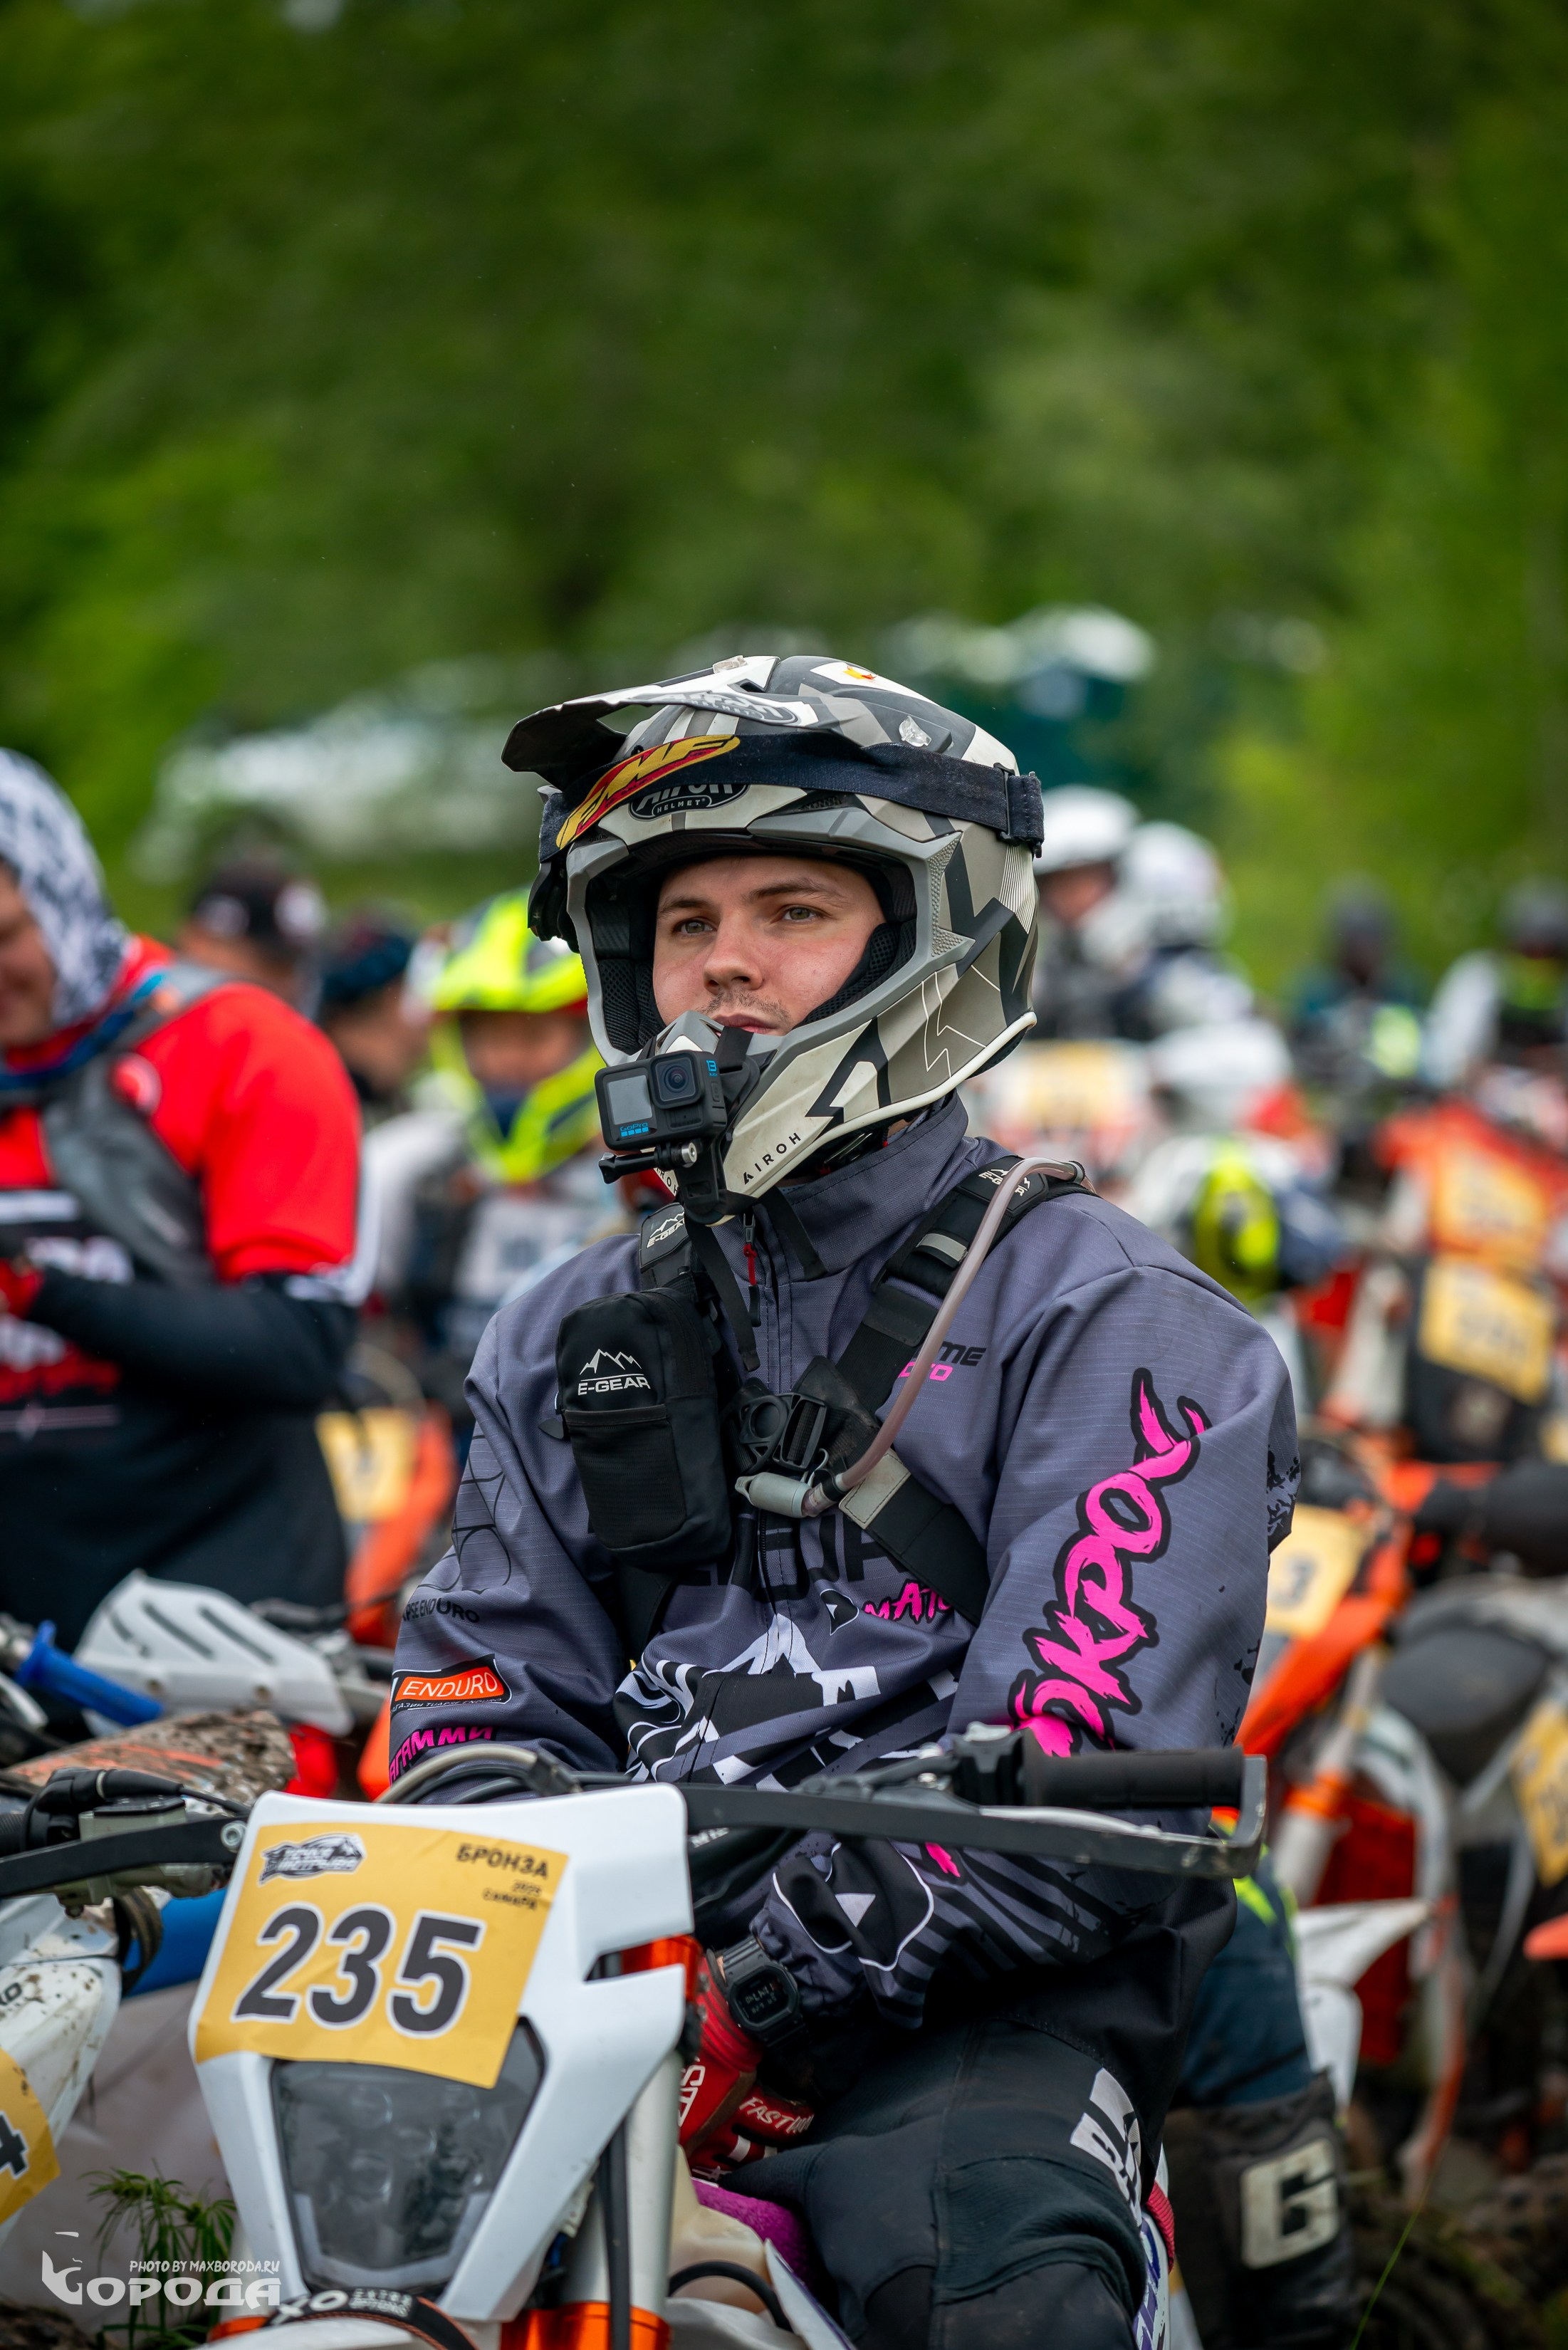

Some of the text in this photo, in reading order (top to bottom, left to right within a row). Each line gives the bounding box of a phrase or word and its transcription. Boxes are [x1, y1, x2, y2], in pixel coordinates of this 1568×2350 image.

[620, 1122, 648, 1132] GoPro
[742, 1132, 801, 1185] AIROH
[577, 1376, 651, 1396] E-GEAR
[419, 1597, 481, 1624] ENDURO
[402, 1672, 498, 1698] ENDURO
[456, 1842, 548, 1881] БРОНЗА
[232, 1902, 485, 2037] 235
